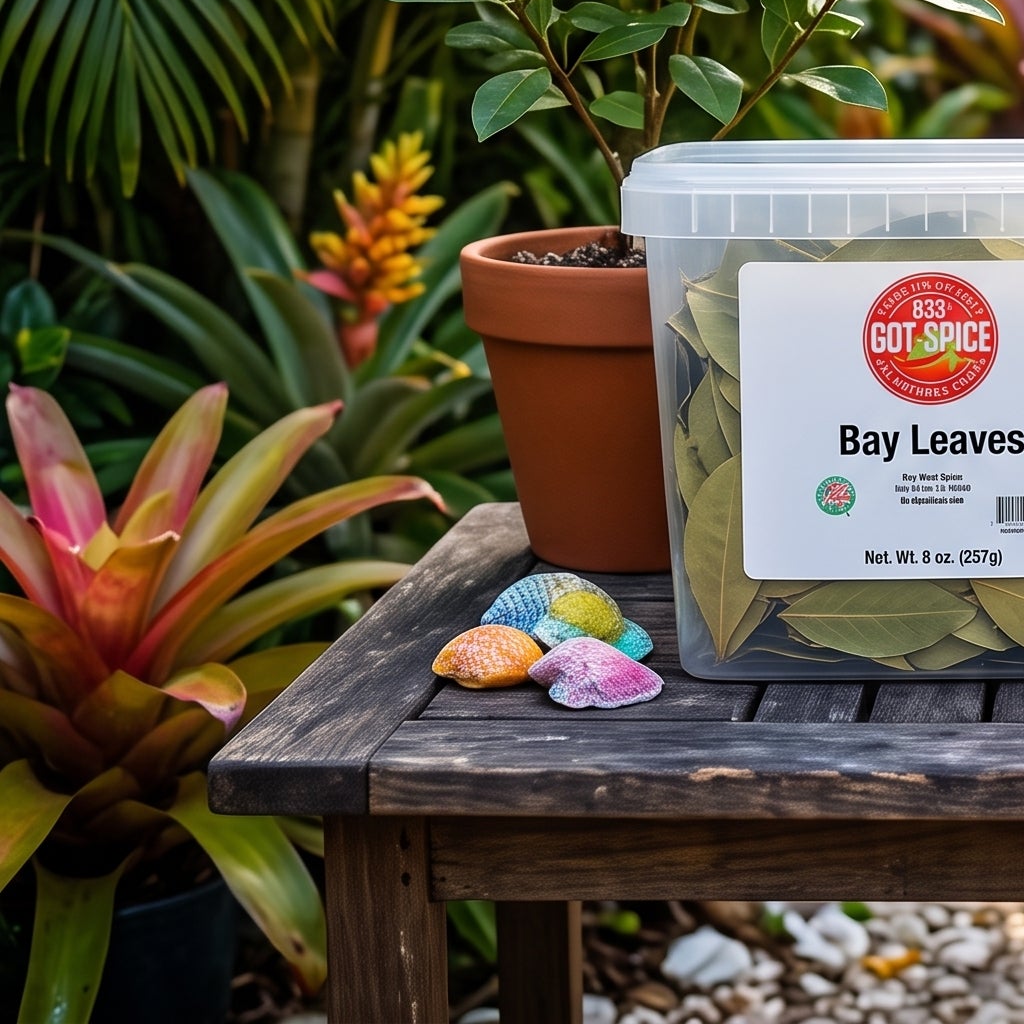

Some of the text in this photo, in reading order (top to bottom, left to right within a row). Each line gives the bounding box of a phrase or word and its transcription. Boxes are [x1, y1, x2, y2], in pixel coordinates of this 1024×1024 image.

[912, 298, 946, 319] 833
[870, 320, 992, 354] GOT SPICE
[840, 424, 1024, 463] Bay Leaves
[864, 549, 1003, 567] Net. Wt. 8 oz. (257g)
